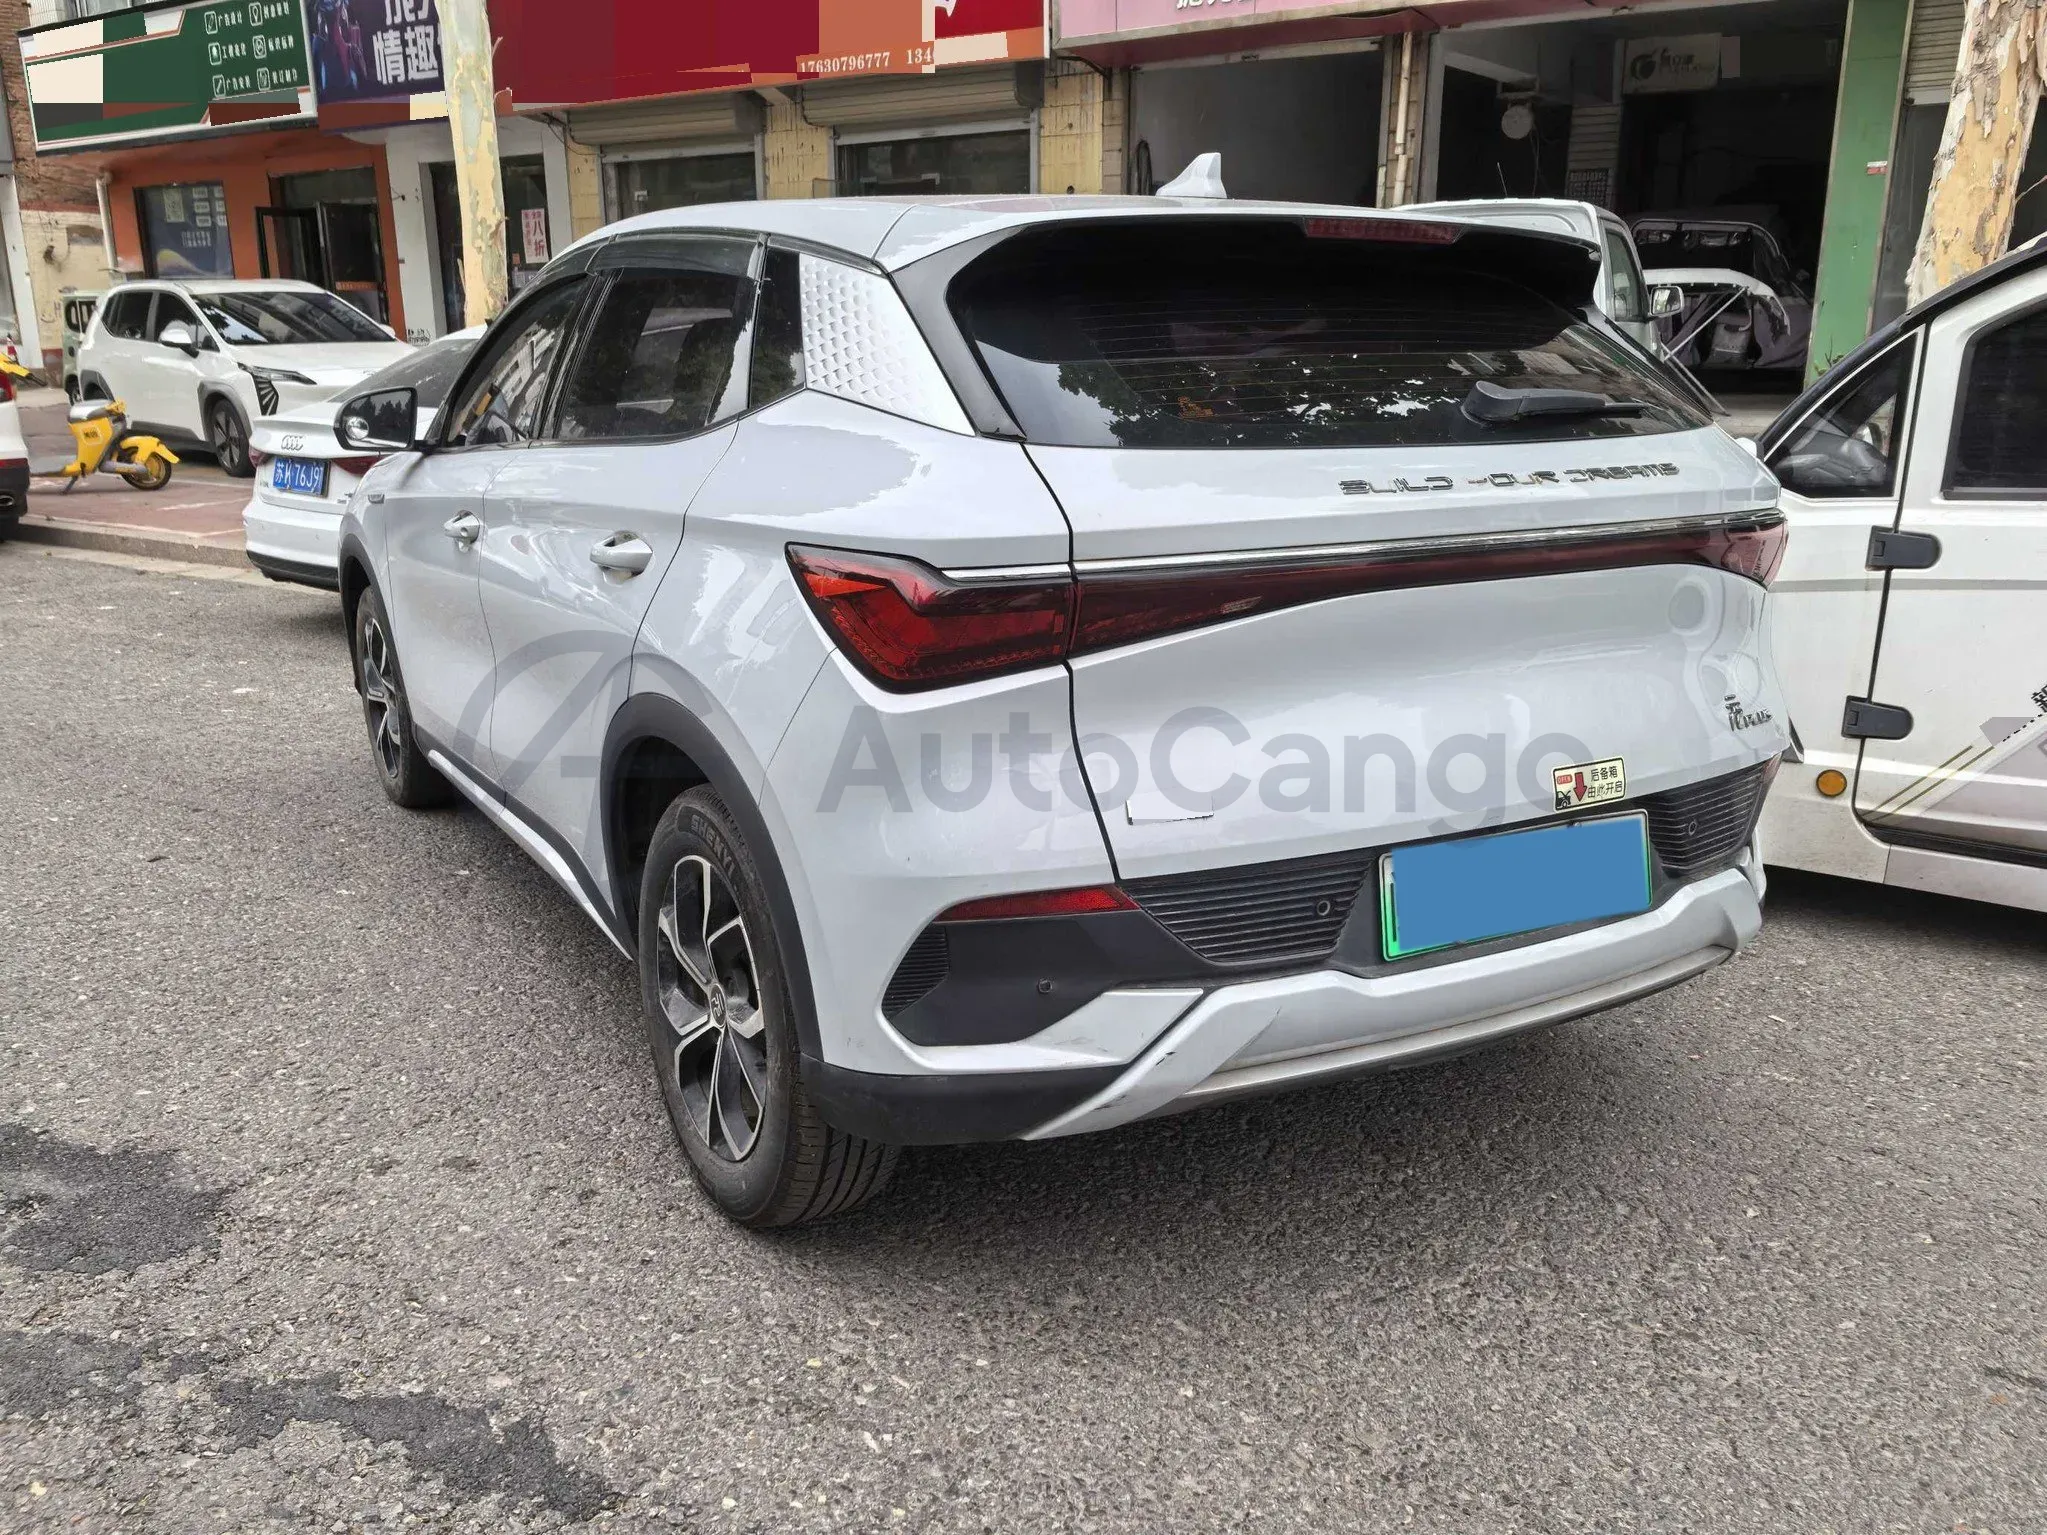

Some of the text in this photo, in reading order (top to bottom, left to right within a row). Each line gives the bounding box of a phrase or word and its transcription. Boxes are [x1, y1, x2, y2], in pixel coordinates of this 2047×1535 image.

[372, 24, 441, 85] 情趣
[906, 46, 934, 64] 134
[1338, 475, 1454, 495] BUILD
[1562, 462, 1680, 482] DREAMS
[1591, 766, 1618, 782] 后备箱
[1588, 781, 1623, 799] 由此开启
